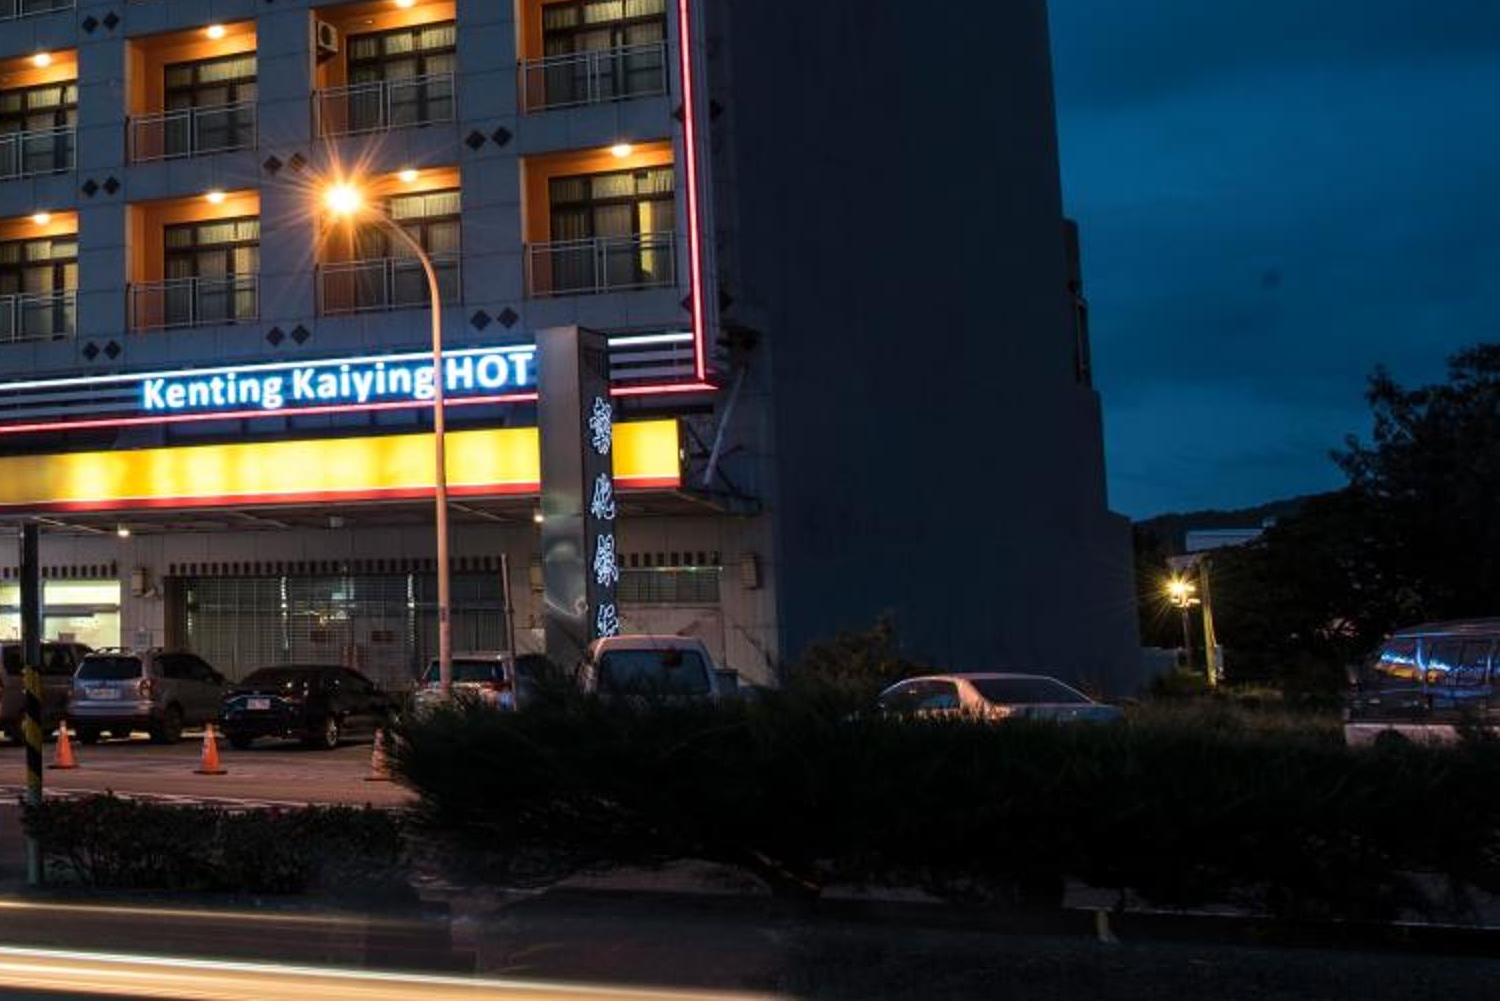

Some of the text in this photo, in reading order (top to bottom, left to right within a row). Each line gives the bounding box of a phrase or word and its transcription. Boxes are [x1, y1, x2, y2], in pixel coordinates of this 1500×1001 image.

[143, 351, 533, 410] Kenting Kaiying HOT
